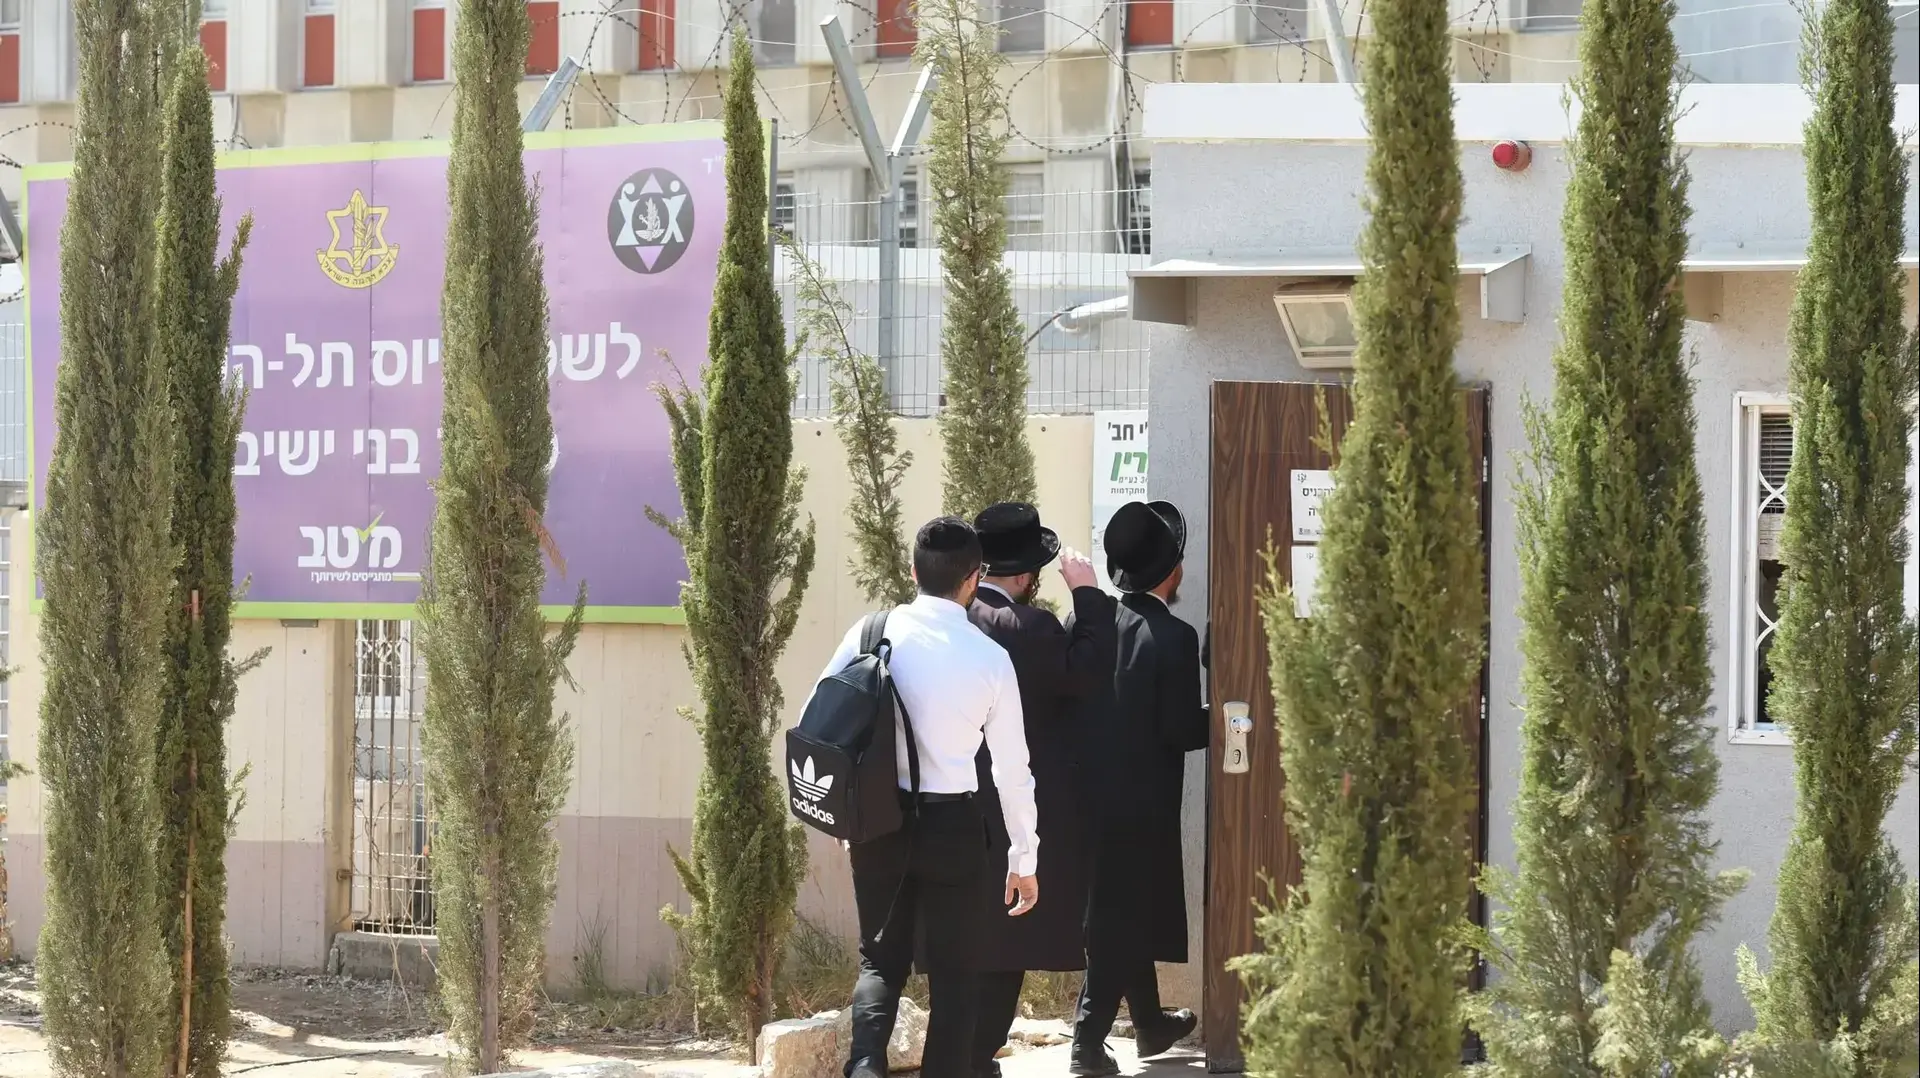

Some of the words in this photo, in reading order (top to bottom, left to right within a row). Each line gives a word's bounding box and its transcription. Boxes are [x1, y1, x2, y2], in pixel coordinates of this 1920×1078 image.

[220, 333, 354, 389] תל-ה
[371, 338, 440, 386] יוס
[231, 429, 335, 476] ישיב
[352, 428, 421, 475] בני
[1110, 451, 1148, 481] רין
[1110, 487, 1146, 496] מתקדמות
[792, 797, 836, 825] adidas
